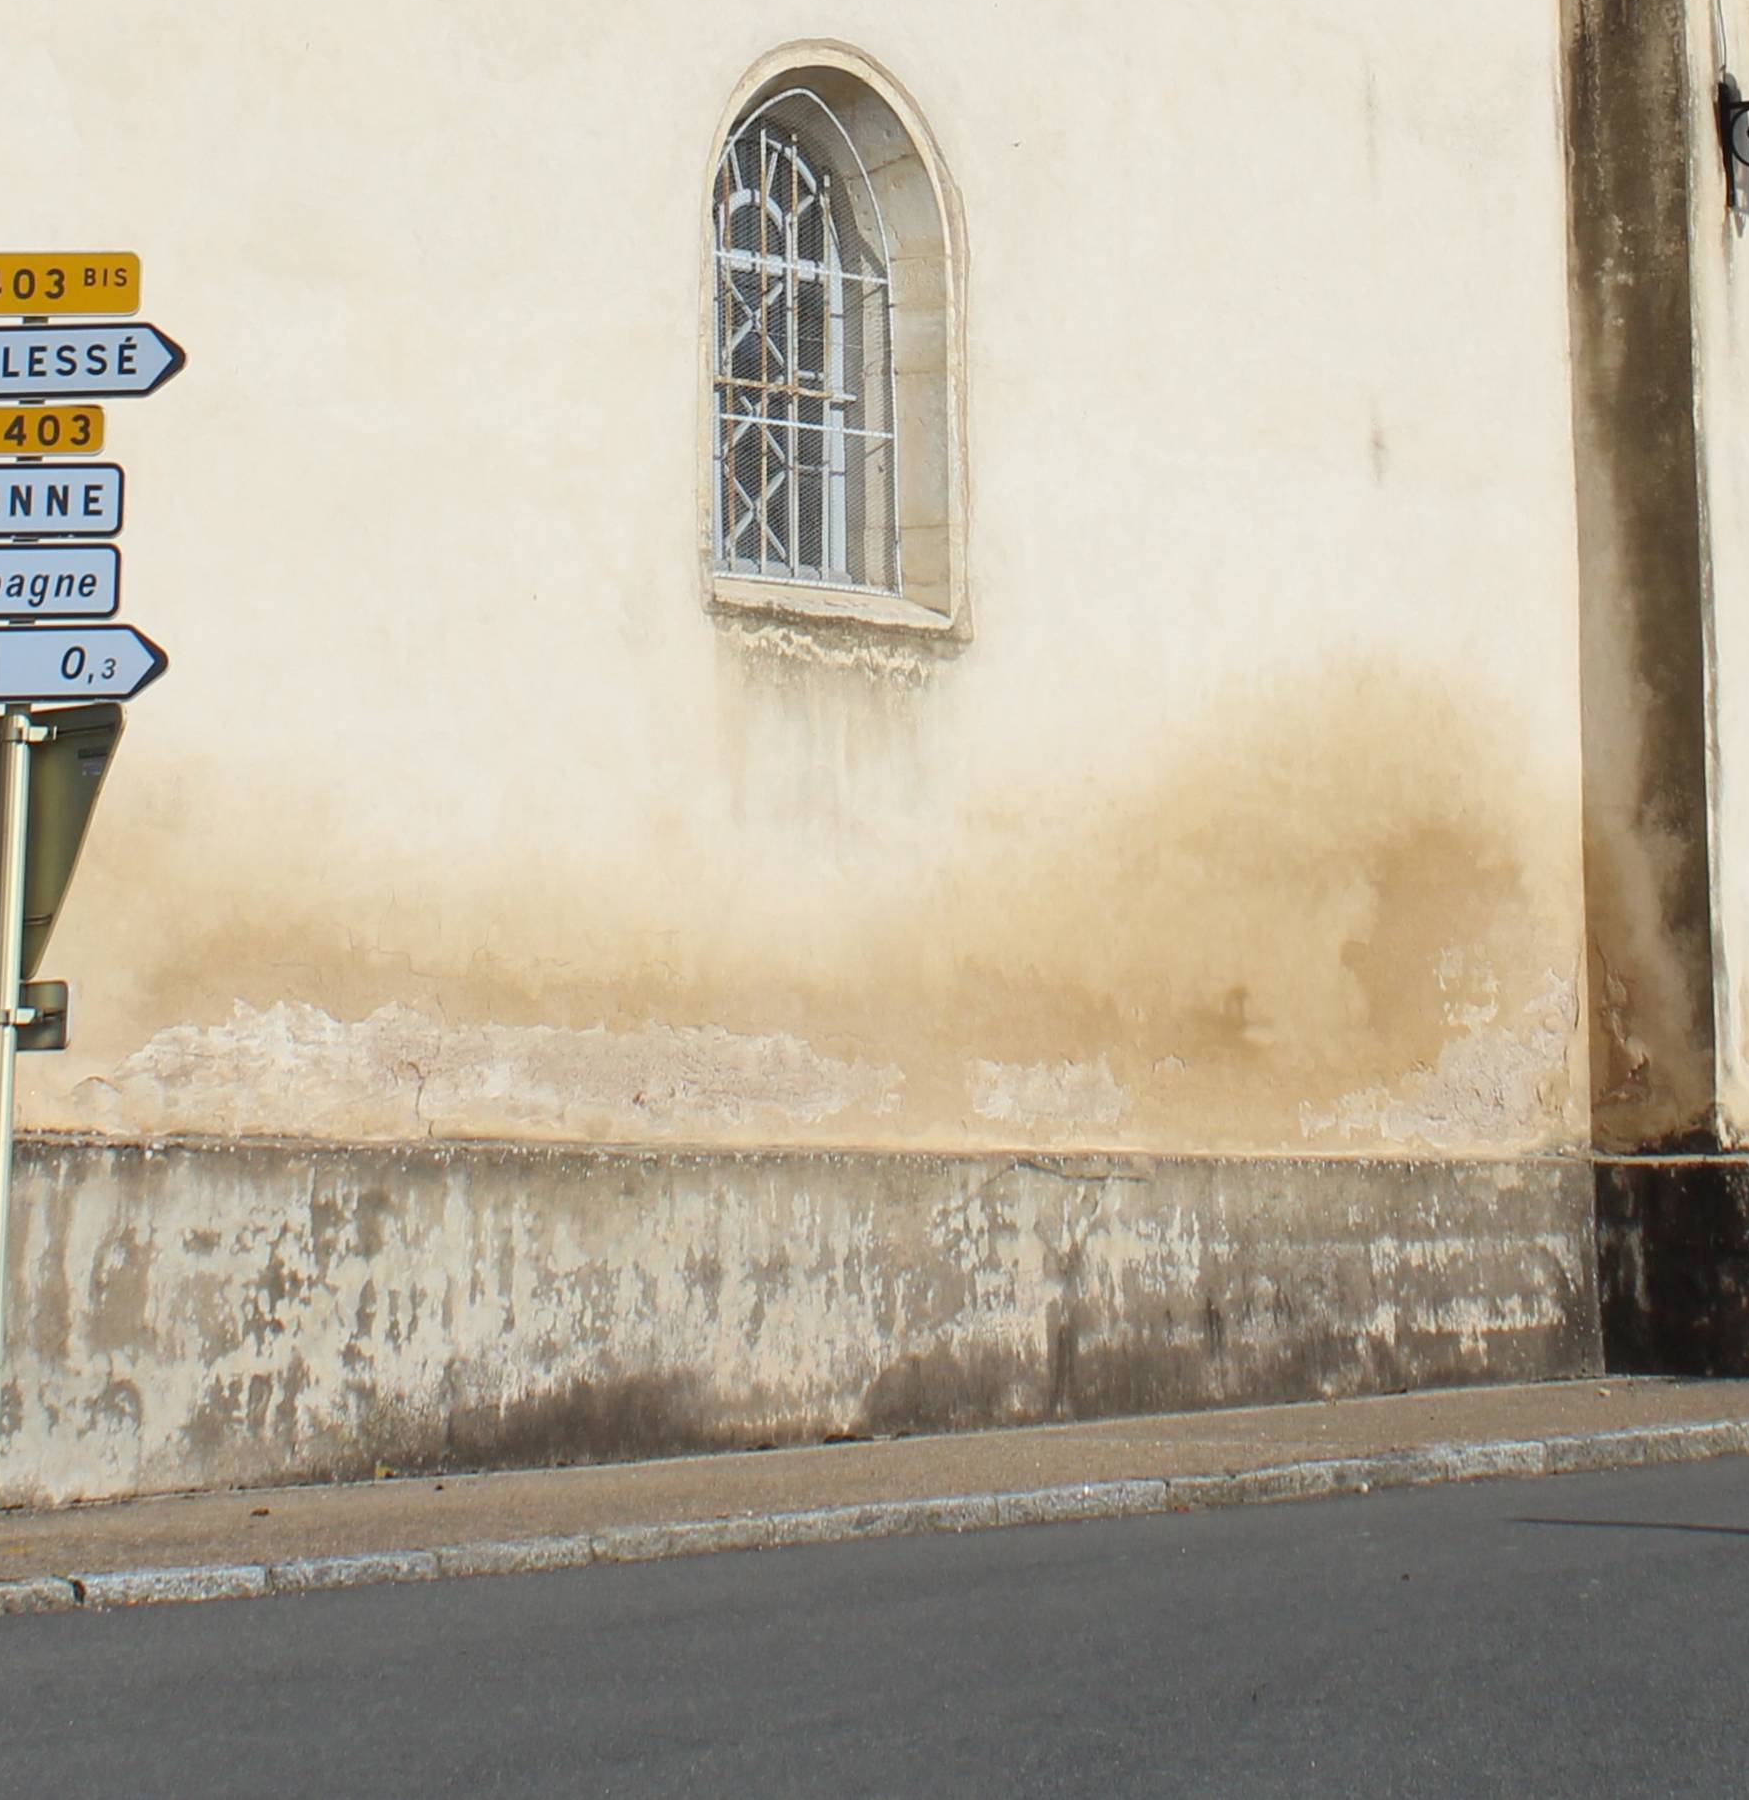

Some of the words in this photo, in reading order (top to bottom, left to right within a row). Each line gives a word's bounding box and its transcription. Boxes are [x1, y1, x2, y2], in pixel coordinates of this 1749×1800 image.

[83, 268, 128, 287] BIS
[3, 414, 91, 447] 403
[60, 645, 117, 684] 0,3
